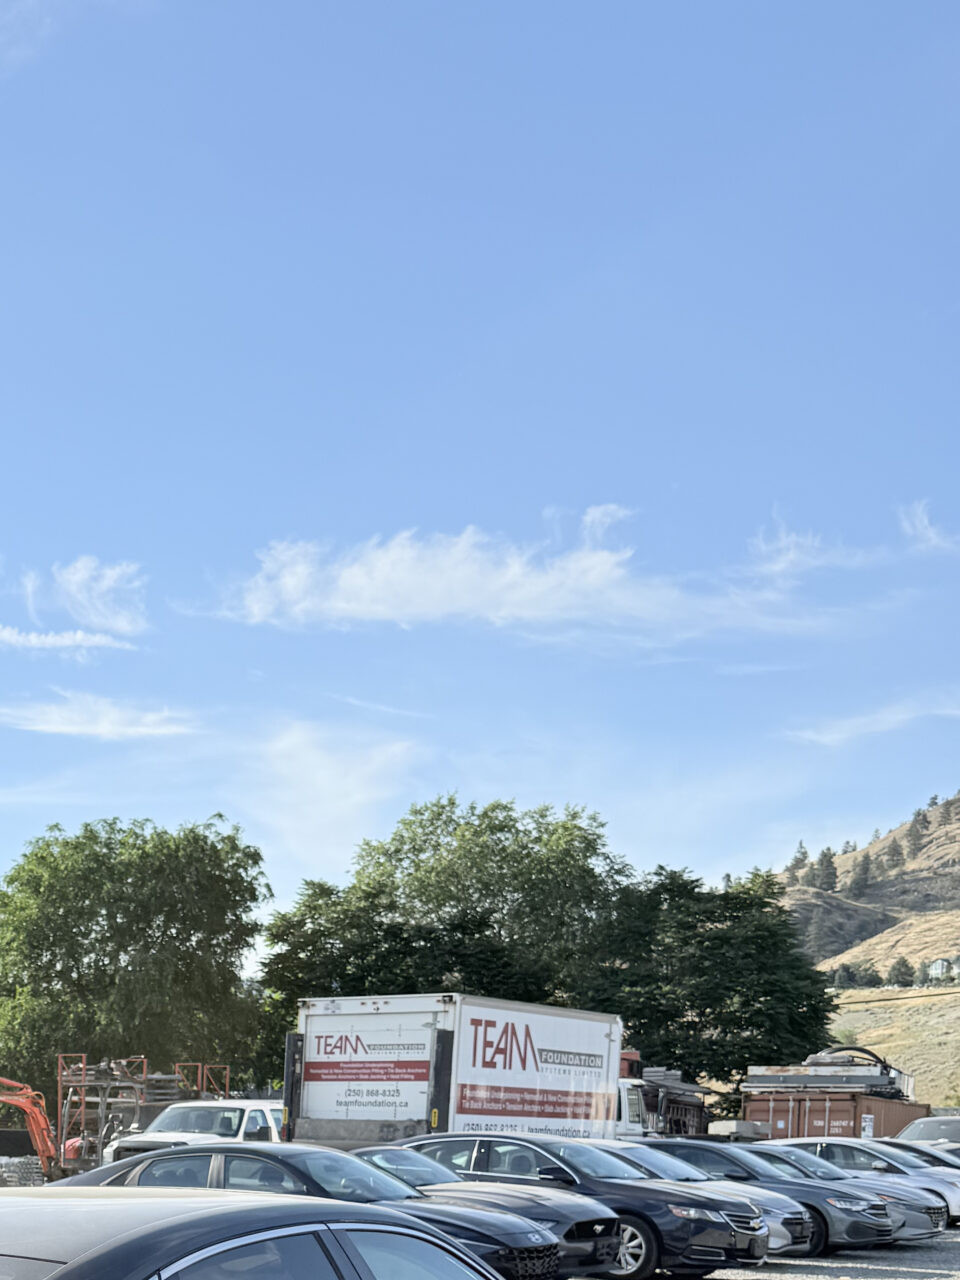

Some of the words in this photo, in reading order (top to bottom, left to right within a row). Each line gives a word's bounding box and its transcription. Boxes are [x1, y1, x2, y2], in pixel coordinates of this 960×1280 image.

[314, 1035, 369, 1055] TEAM
[469, 1018, 539, 1072] TEAM
[541, 1051, 602, 1067] FOUNDATION
[345, 1089, 364, 1097] (250)
[365, 1089, 400, 1097] 868-8325
[336, 1099, 409, 1108] teamfoundation.ca
